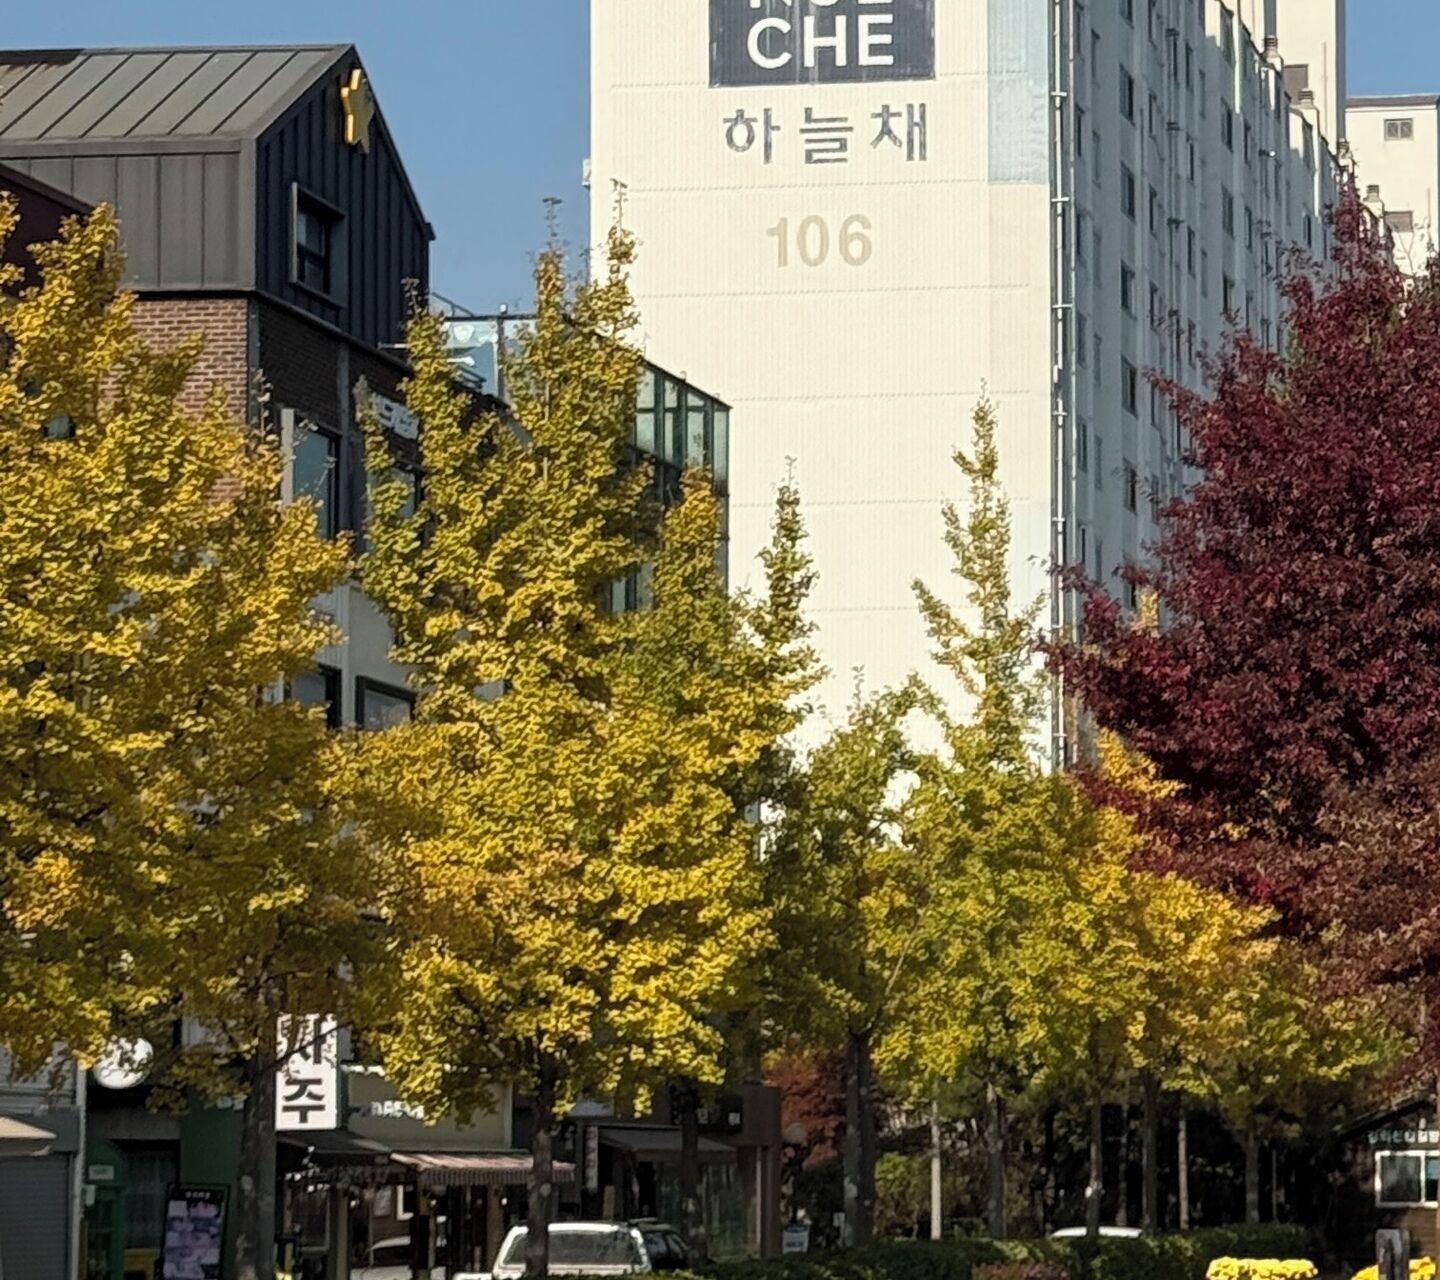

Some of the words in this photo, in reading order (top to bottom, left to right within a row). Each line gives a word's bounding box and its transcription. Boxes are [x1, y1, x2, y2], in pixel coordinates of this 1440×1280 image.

[747, 13, 895, 70] CHE
[723, 102, 928, 165] 하늘채
[766, 212, 873, 268] 106
